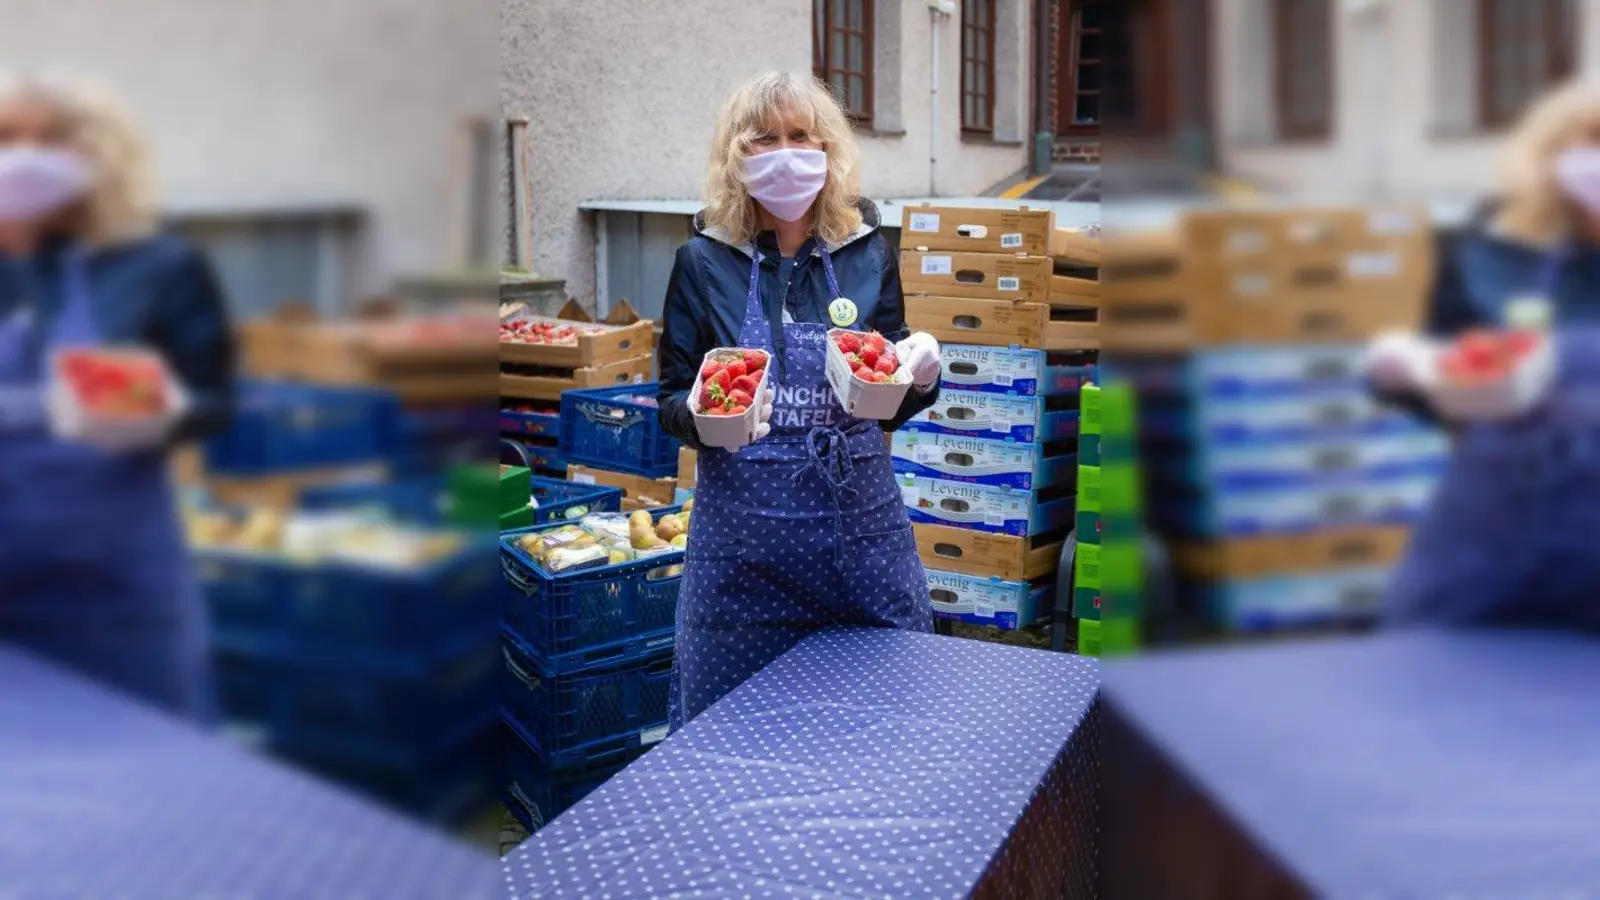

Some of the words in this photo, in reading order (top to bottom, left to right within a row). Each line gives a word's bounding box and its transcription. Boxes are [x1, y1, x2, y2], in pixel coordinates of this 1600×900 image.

[794, 329, 826, 342] Evelyn
[774, 408, 835, 426] TAFEL
[930, 480, 982, 502] Levenig
[928, 573, 970, 593] evenig
